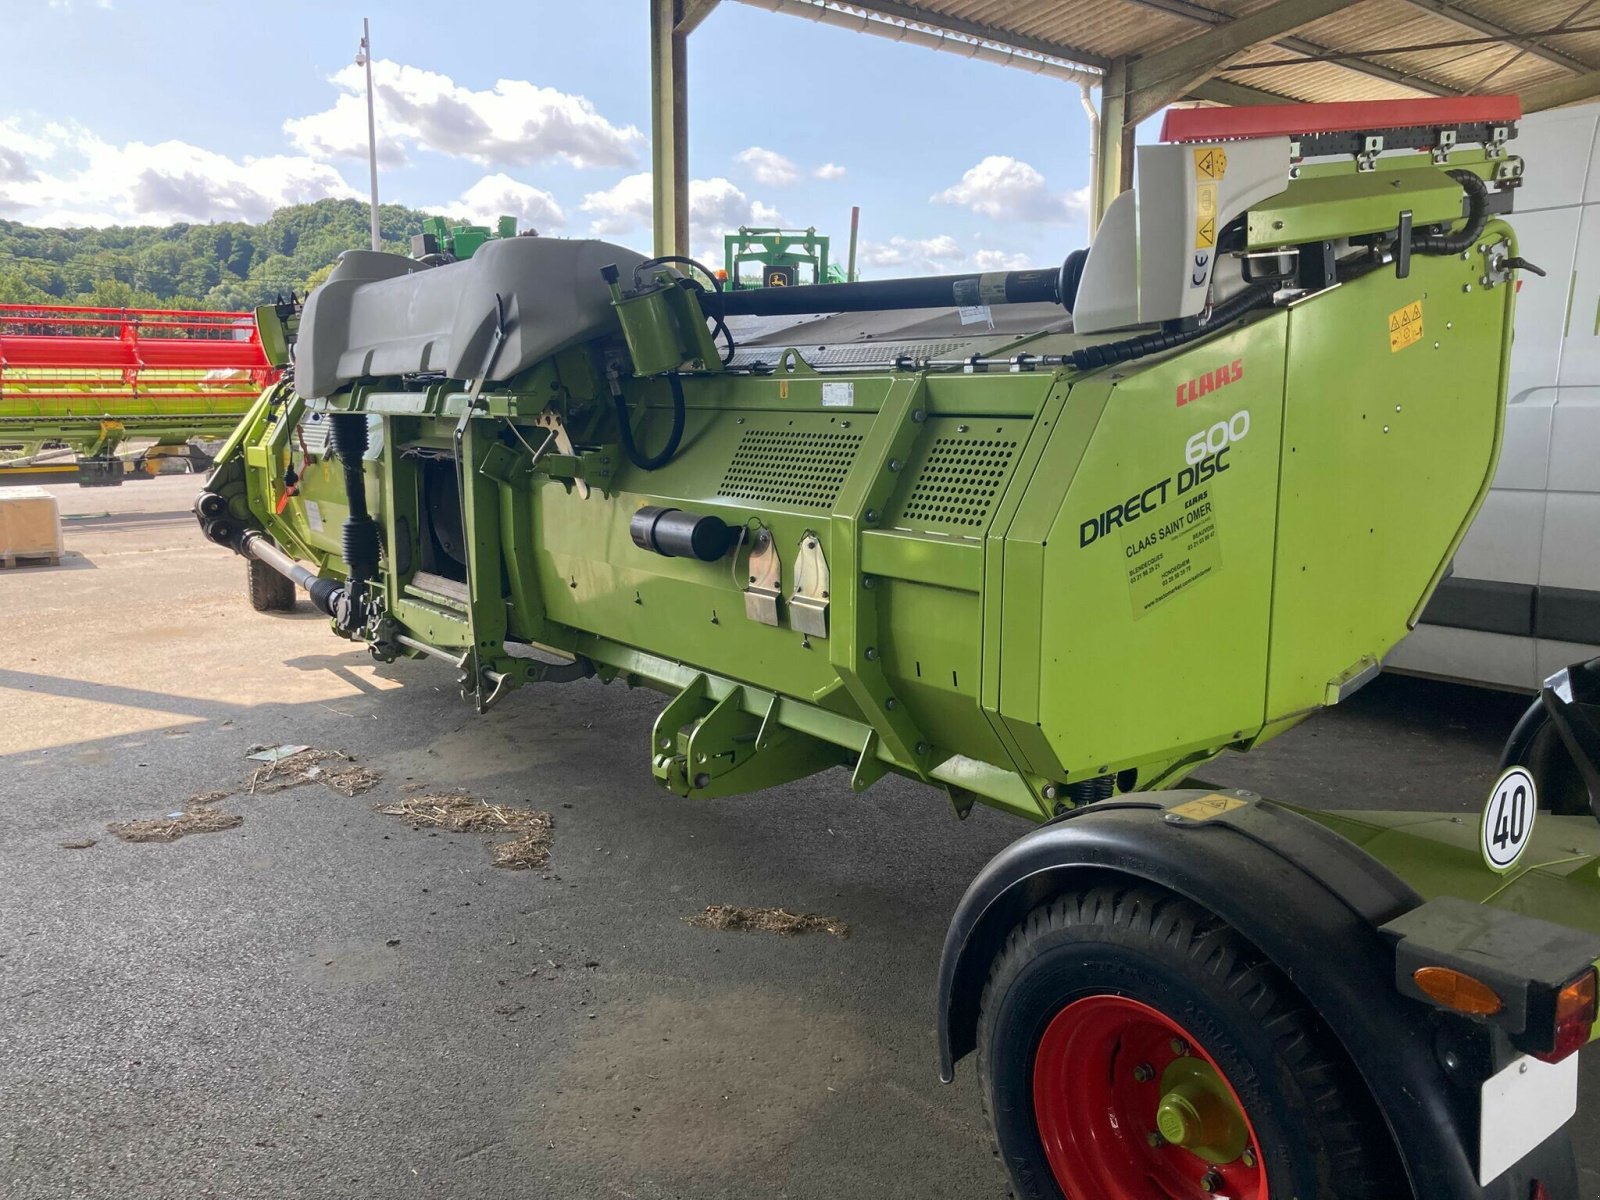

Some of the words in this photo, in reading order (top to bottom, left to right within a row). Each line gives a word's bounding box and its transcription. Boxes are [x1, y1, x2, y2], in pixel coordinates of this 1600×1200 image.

[1176, 358, 1244, 408] CLAAS
[1185, 410, 1251, 466] 600
[1080, 477, 1172, 549] DIRECT
[1177, 446, 1231, 496] DISC
[1184, 491, 1208, 509] CLAAS
[1126, 533, 1157, 558] CLAAS
[1158, 516, 1185, 540] SAINT
[1186, 502, 1212, 524] OMER
[1493, 785, 1526, 850] 40
